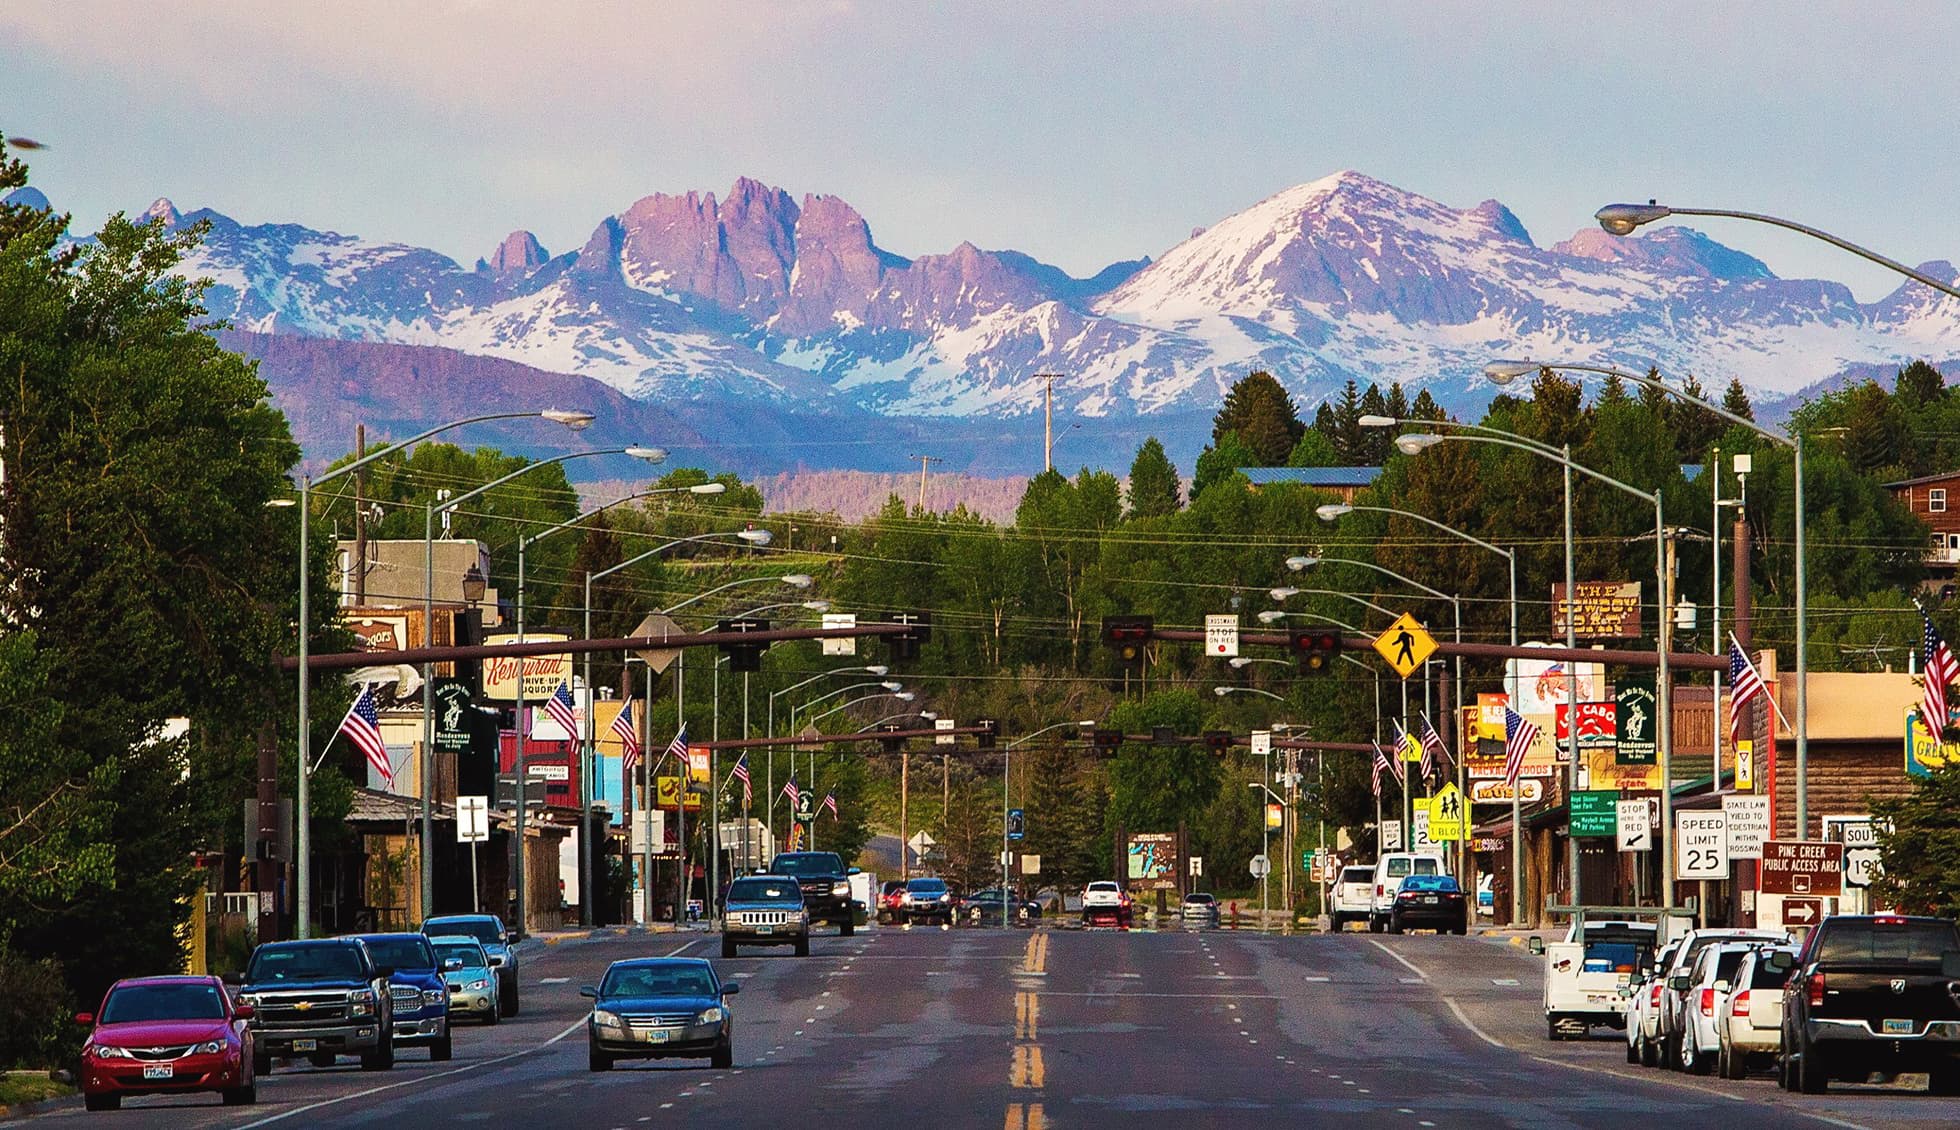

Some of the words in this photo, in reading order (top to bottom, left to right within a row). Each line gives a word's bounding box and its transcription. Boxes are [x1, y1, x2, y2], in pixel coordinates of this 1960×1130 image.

[1577, 585, 1615, 597] THE
[1558, 597, 1637, 613] COWBOY
[1209, 628, 1235, 636] STOP
[522, 677, 560, 685] RIVE-UP
[524, 685, 557, 694] IQUOR
[1582, 704, 1617, 725] CABO
[1472, 766, 1507, 776] PACKAG
[1615, 779, 1647, 788] Estate
[1477, 785, 1535, 799] MUSC
[1621, 805, 1645, 814] STOP
[1726, 801, 1746, 809] STATE
[1750, 801, 1766, 809] LAW
[1730, 812, 1751, 820] YIELD
[1753, 812, 1763, 820] TO
[1624, 823, 1643, 832] RED
[1682, 819, 1724, 830] SPEED
[1728, 823, 1768, 831] EDESTRIAN
[1686, 835, 1718, 845] LIMIT
[1735, 834, 1759, 842] WITHIN
[1847, 829, 1879, 842] SOUT
[1729, 845, 1761, 853] ROSSWA
[1778, 845, 1797, 858] PINE
[1799, 846, 1827, 858] CREEK
[1687, 849, 1719, 870] 25
[1764, 859, 1789, 872] PUBLIC
[1790, 860, 1819, 873] ACCESS
[1820, 860, 1841, 873] AREA
